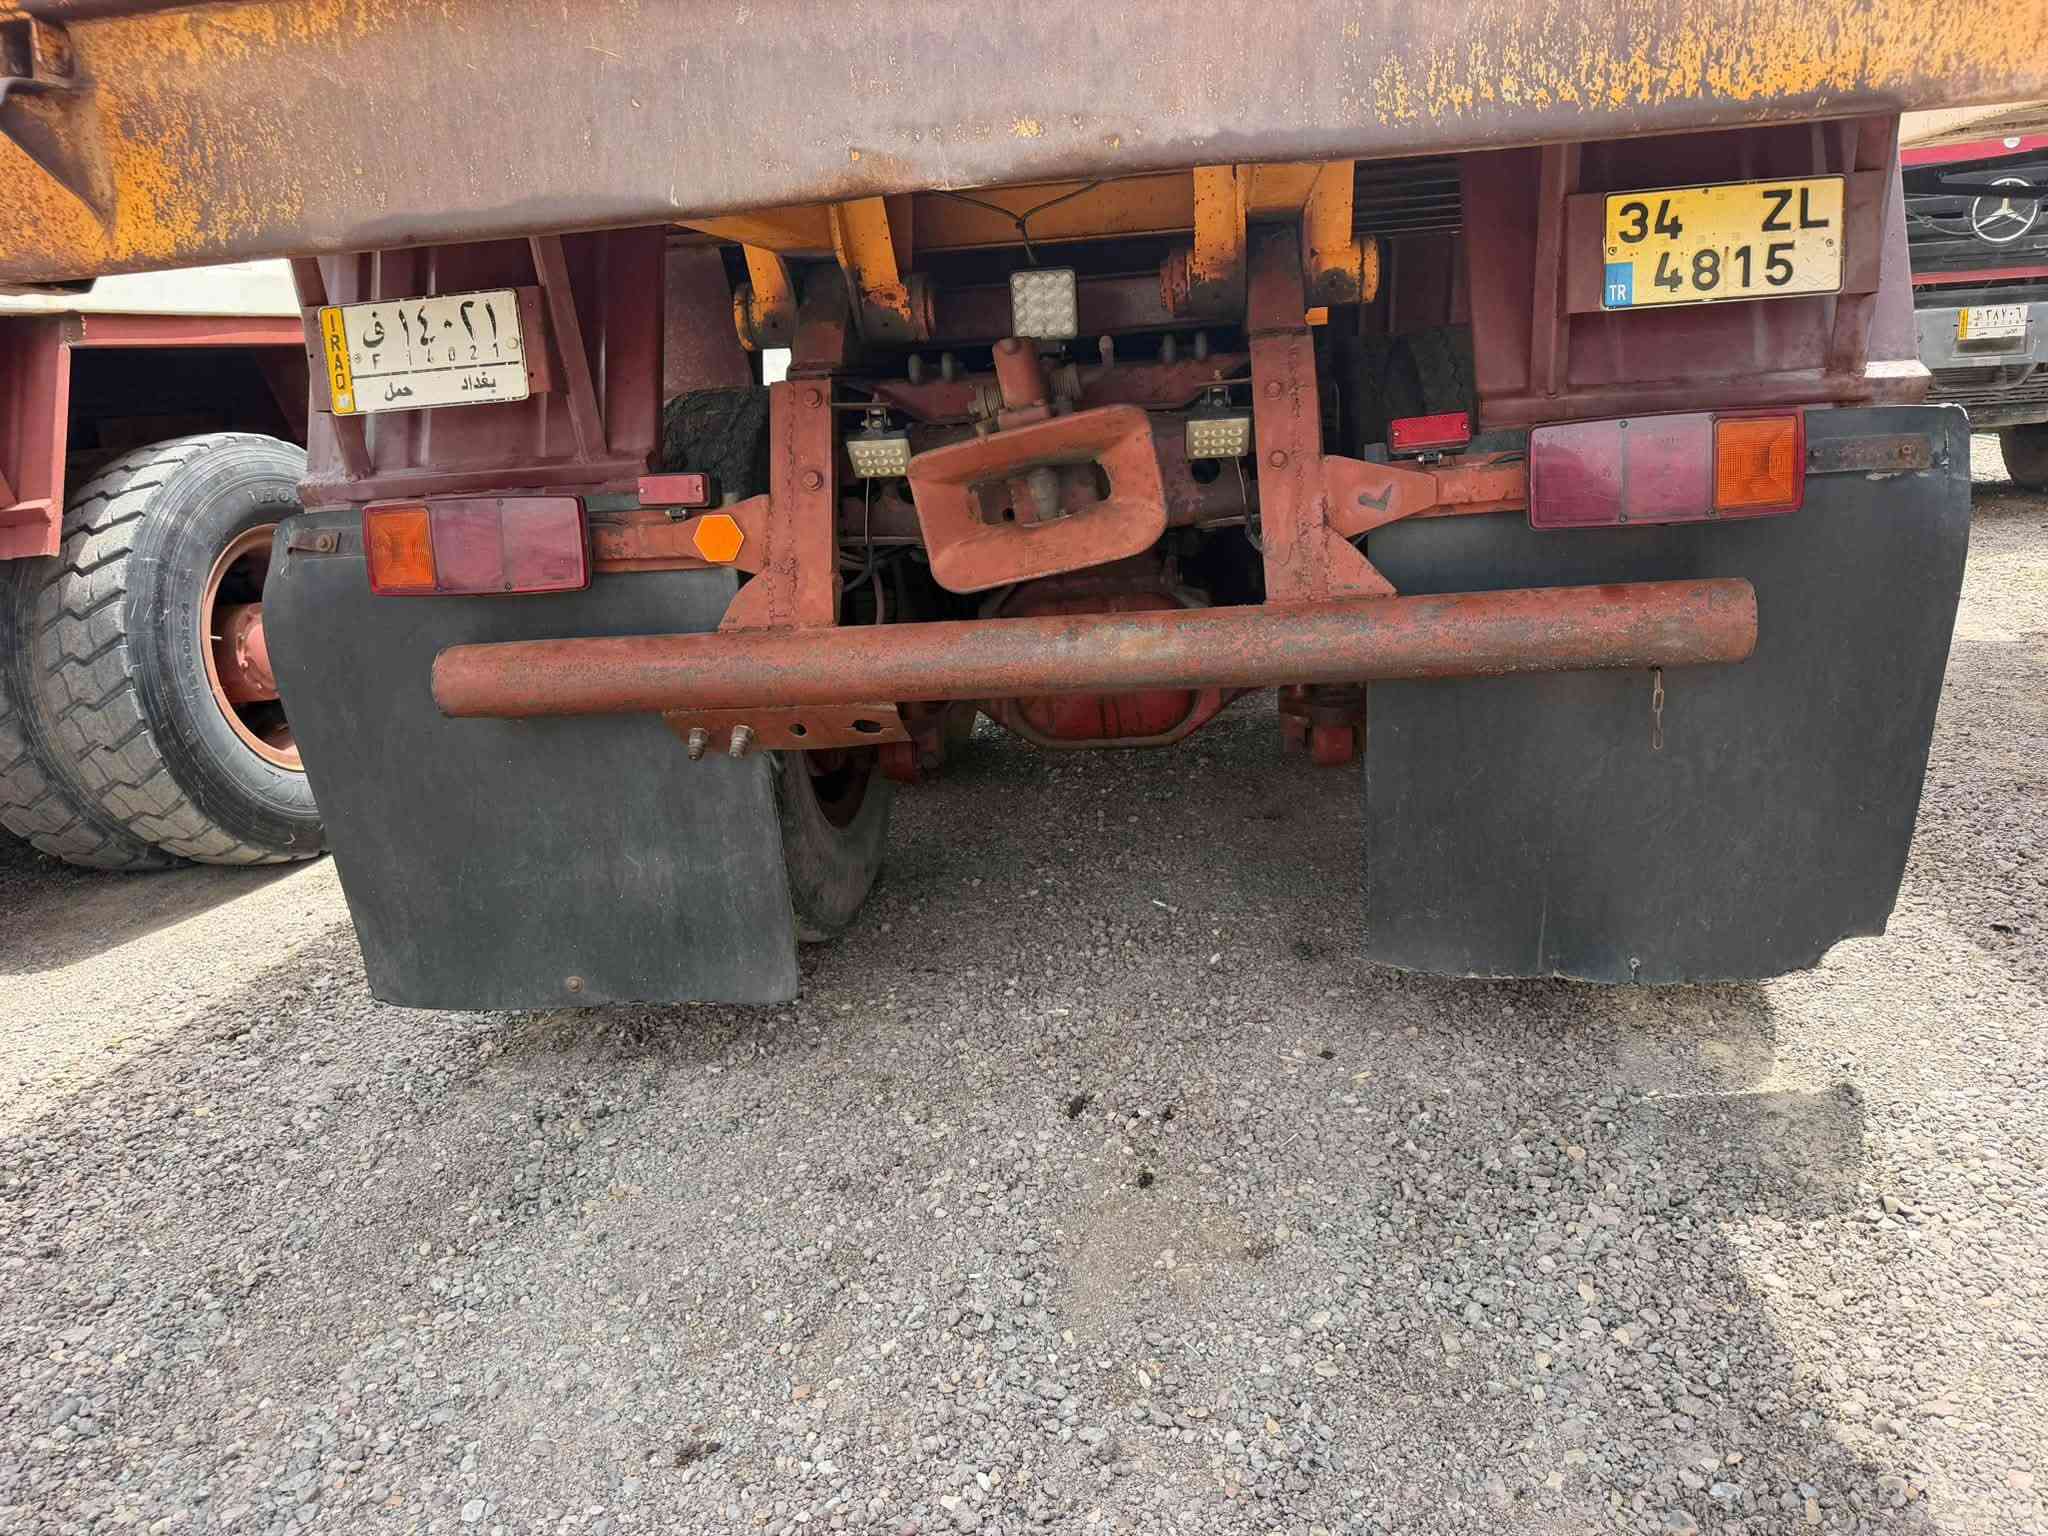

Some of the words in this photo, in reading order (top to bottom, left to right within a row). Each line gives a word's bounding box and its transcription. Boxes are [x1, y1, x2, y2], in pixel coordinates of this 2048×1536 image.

[1618, 199, 1684, 243] 34
[1761, 187, 1830, 232] ZL
[1654, 242, 1796, 292] 4815
[1608, 284, 1627, 301] TR
[461, 371, 497, 394] بغداد
